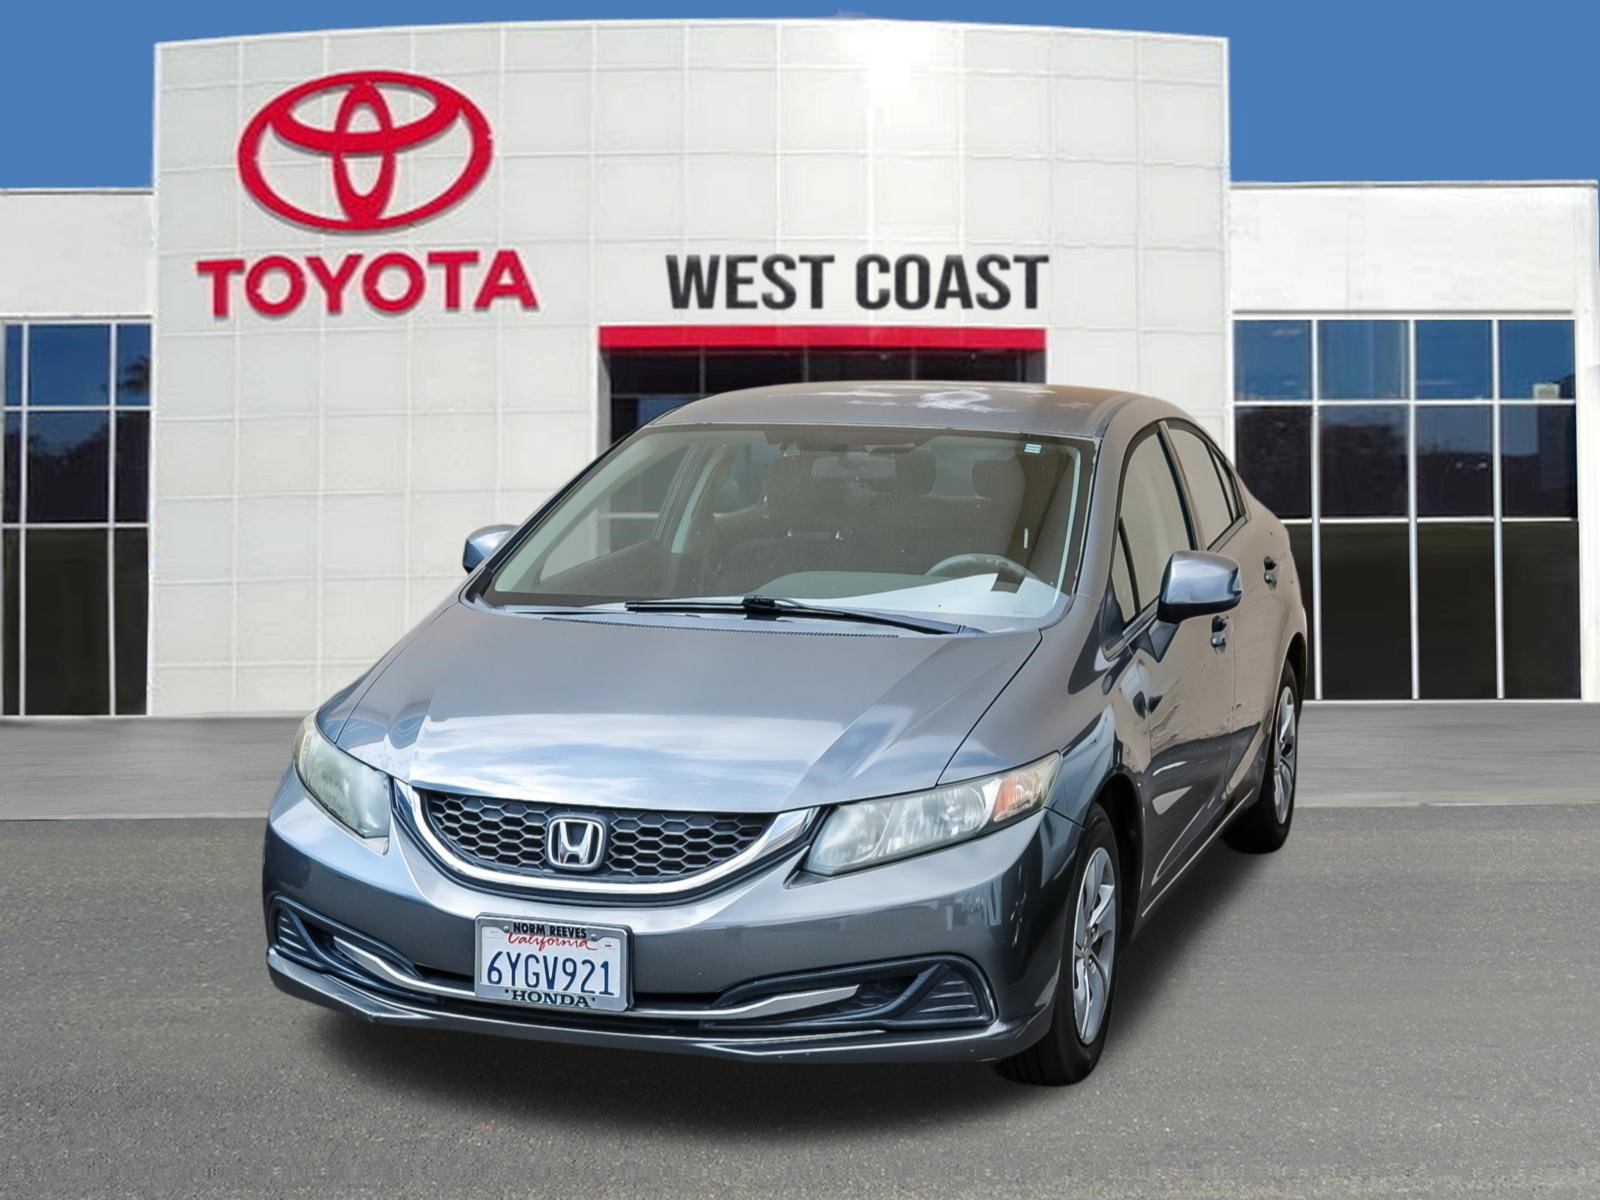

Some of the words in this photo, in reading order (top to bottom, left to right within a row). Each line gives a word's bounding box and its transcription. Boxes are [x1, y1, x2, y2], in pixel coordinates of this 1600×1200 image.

[196, 249, 539, 318] TOYOTA
[665, 253, 836, 310] WEST
[855, 253, 1050, 311] COAST
[513, 922, 546, 936] NORM
[550, 924, 587, 939] REEVES
[487, 951, 615, 996] 6YGV921
[511, 989, 592, 1008] HONDA
